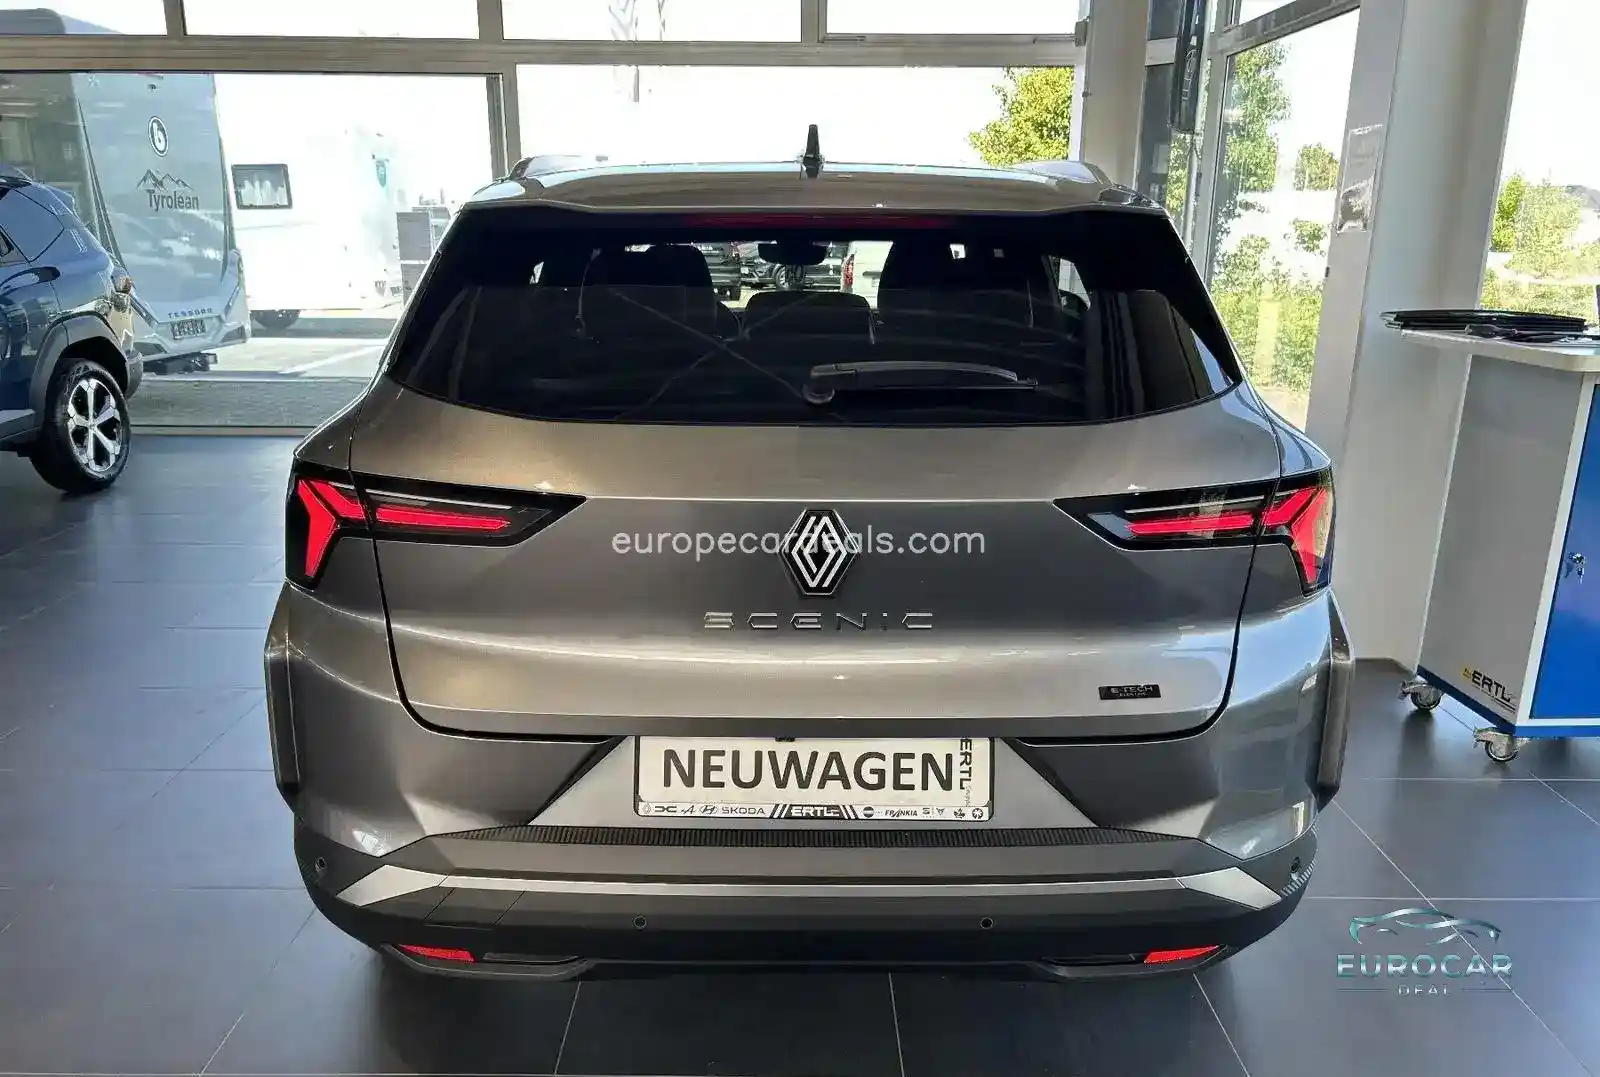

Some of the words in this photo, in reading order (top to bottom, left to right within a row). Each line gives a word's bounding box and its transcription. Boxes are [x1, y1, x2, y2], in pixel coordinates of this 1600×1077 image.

[145, 189, 199, 212] Tyrolean
[1471, 670, 1511, 703] ERTL
[663, 749, 953, 791] NEUWAGEN
[959, 738, 973, 790] ERTL
